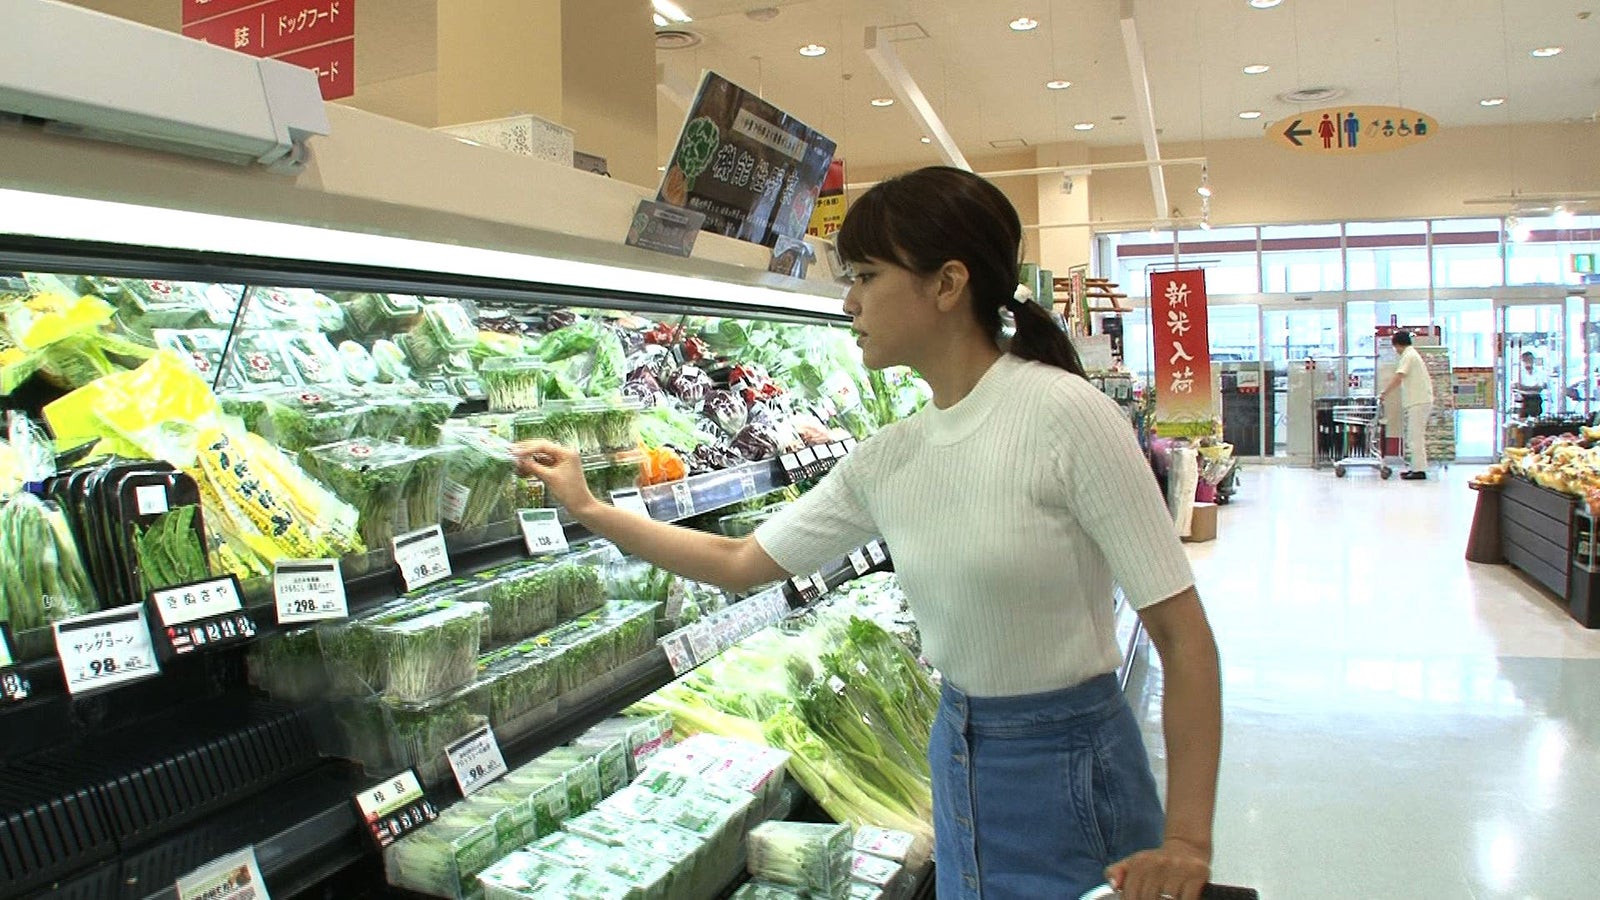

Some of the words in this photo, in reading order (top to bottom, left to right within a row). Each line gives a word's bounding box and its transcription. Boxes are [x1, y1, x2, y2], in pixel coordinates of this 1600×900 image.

[278, 2, 339, 36] ドッグフード
[1165, 281, 1195, 394] 新米入荷
[167, 585, 227, 609] きぬさや
[294, 599, 315, 613] 298
[73, 636, 134, 654] ヤングコーン
[90, 657, 116, 676] 98
